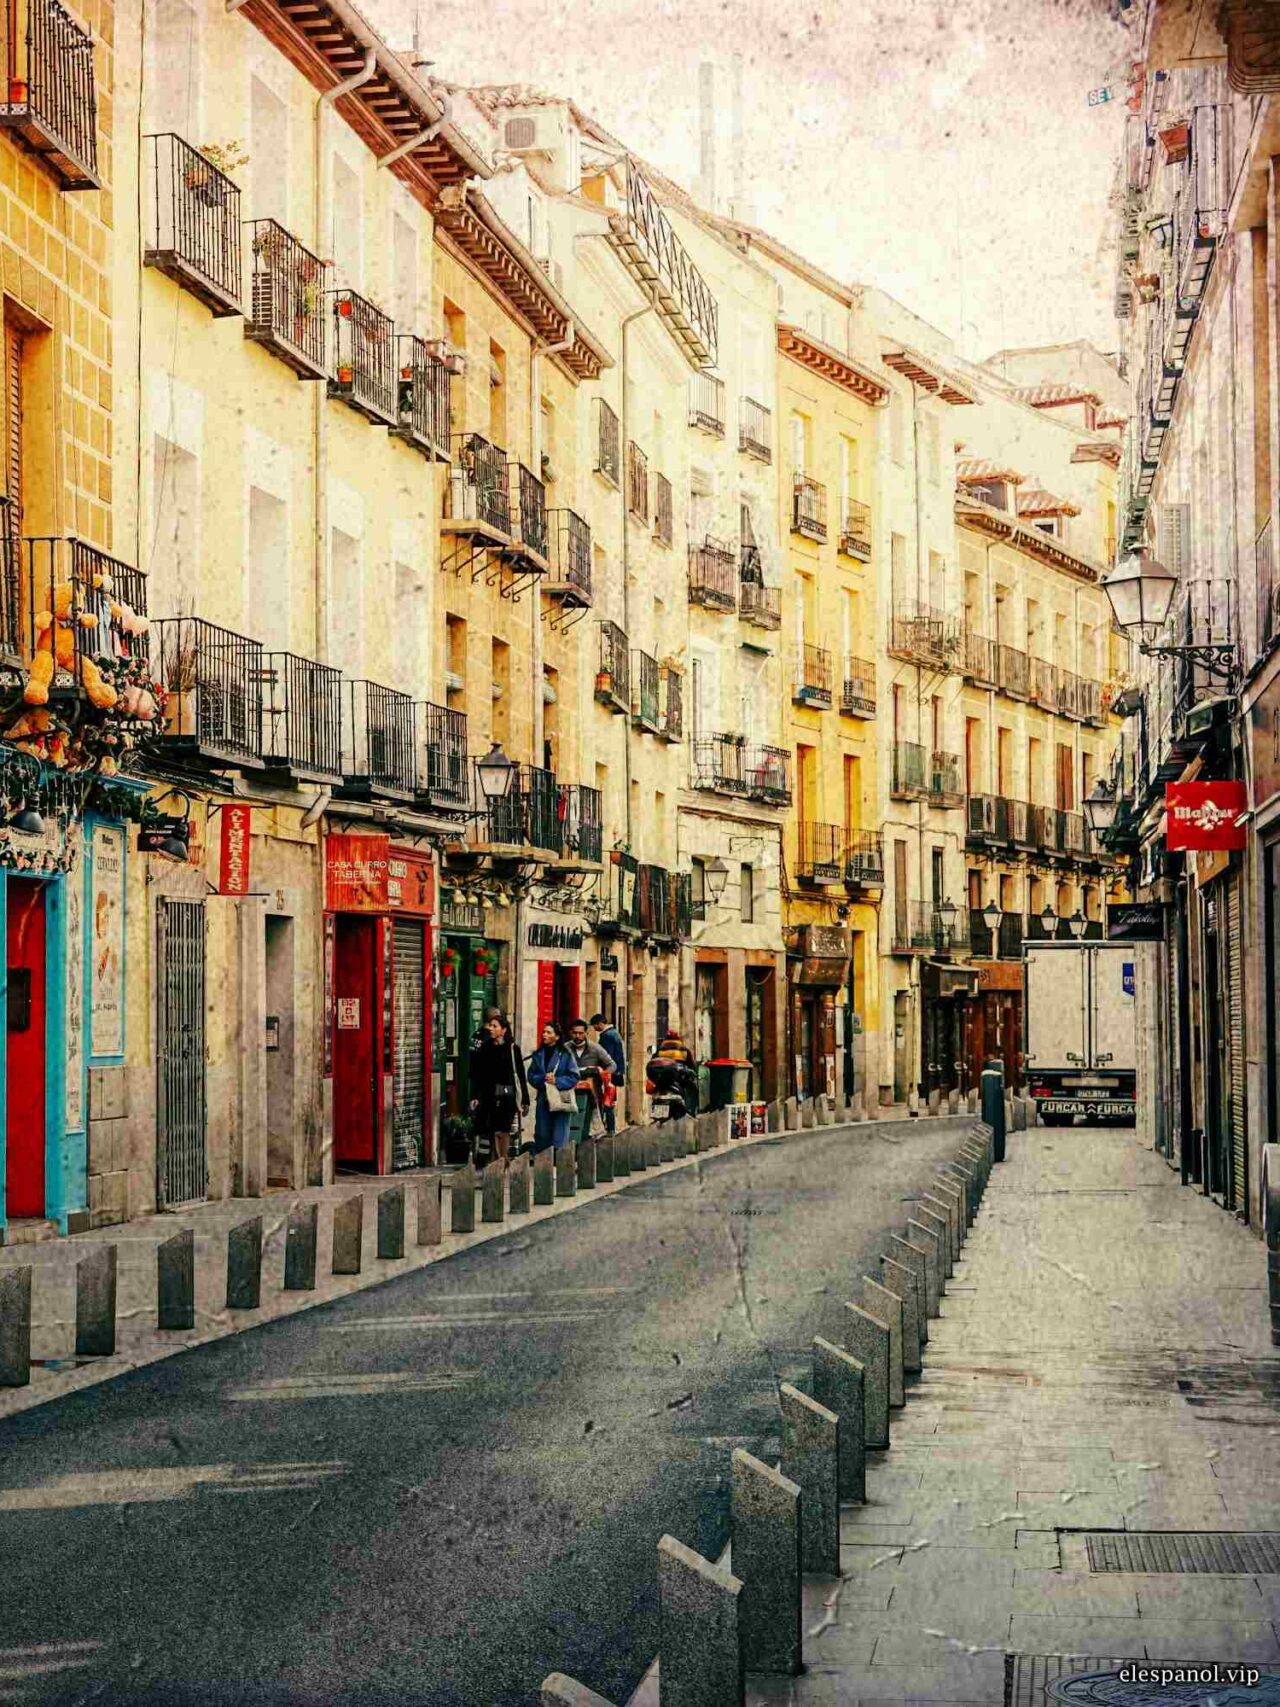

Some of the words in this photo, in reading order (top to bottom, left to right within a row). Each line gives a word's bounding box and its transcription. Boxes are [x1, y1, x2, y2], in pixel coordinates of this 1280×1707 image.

[327, 861, 352, 869] CASA
[1041, 1102, 1086, 1113] FURCAR
[1097, 1103, 1136, 1114] FURCA
